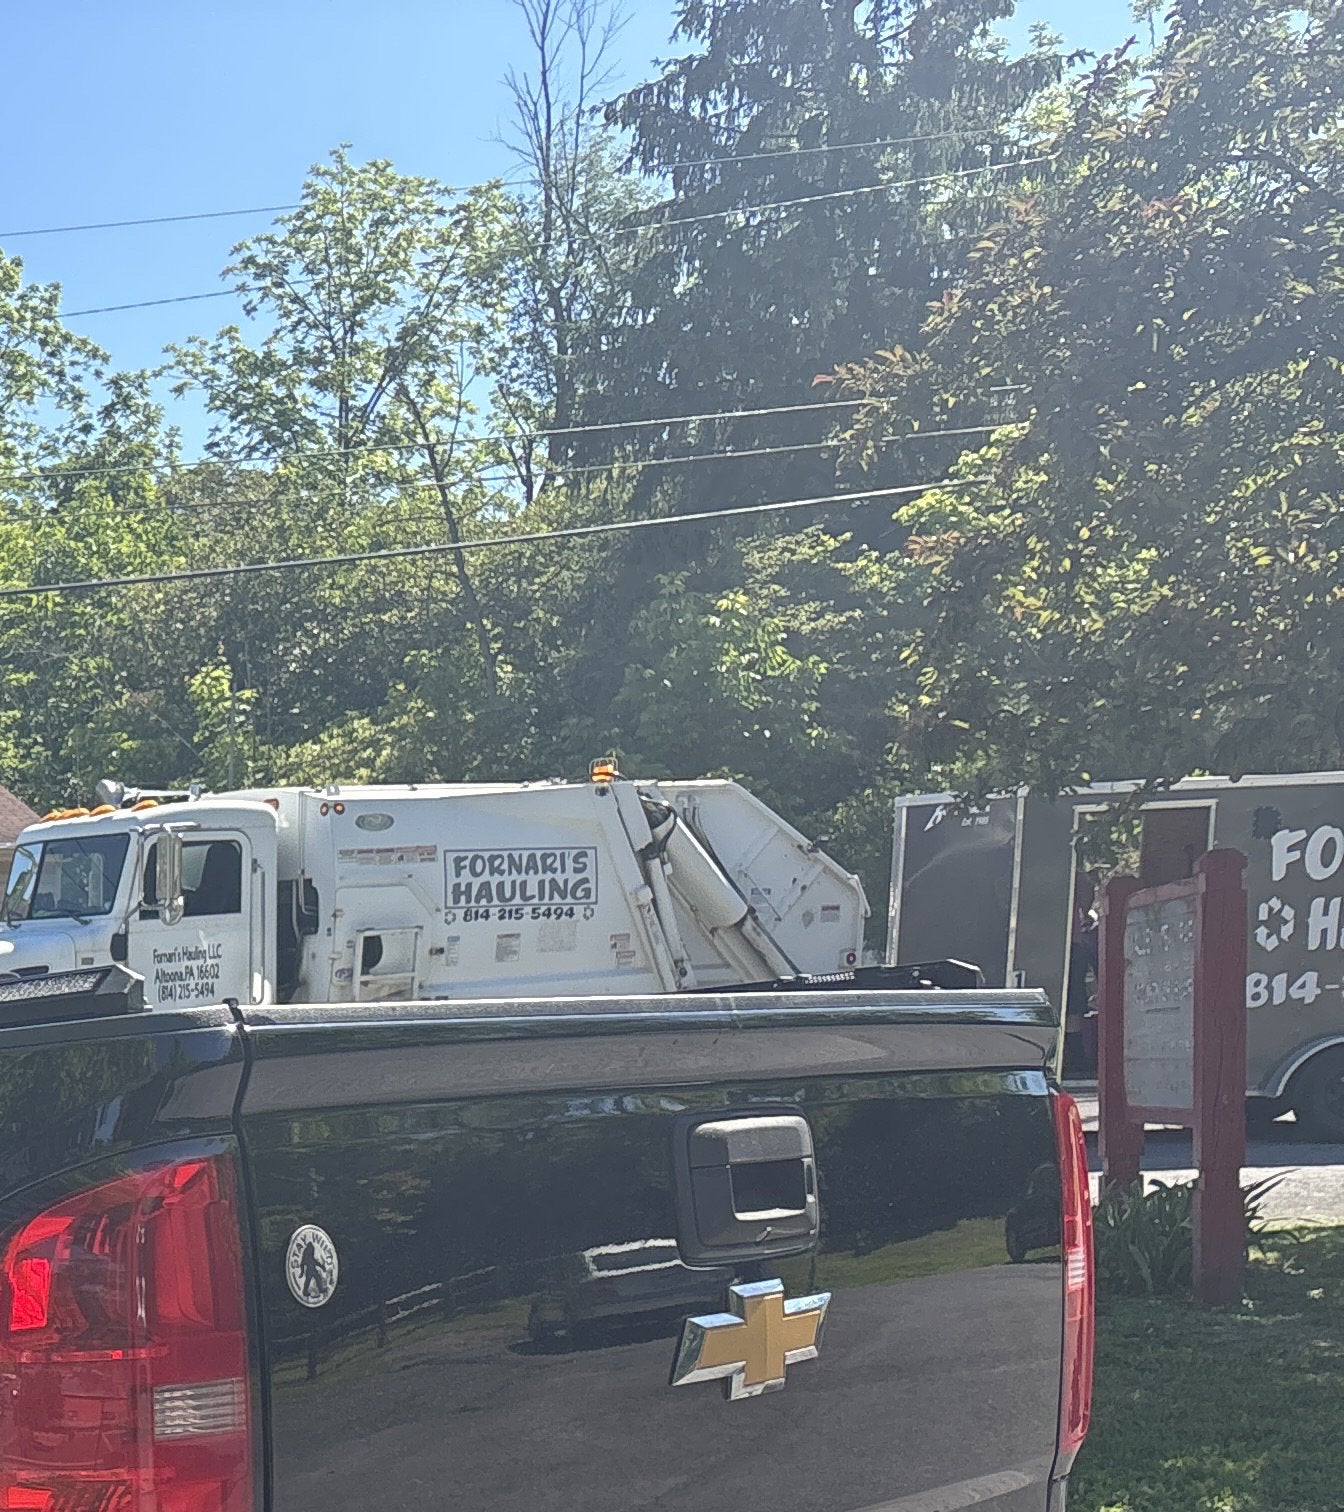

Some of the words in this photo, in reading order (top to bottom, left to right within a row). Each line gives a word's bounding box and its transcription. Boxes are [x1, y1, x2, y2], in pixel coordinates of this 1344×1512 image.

[452, 850, 589, 879] FORNARI'S
[451, 877, 592, 906] HAULING
[462, 906, 576, 923] 814-215-5494
[1308, 896, 1344, 951] H
[182, 946, 207, 963] Hauling
[208, 943, 222, 960] LLC
[197, 963, 220, 981] 16602
[178, 981, 215, 1000] 215-5494
[1245, 970, 1344, 1009] 814-
[291, 1233, 309, 1269] STAY
[312, 1231, 334, 1266] WILD
